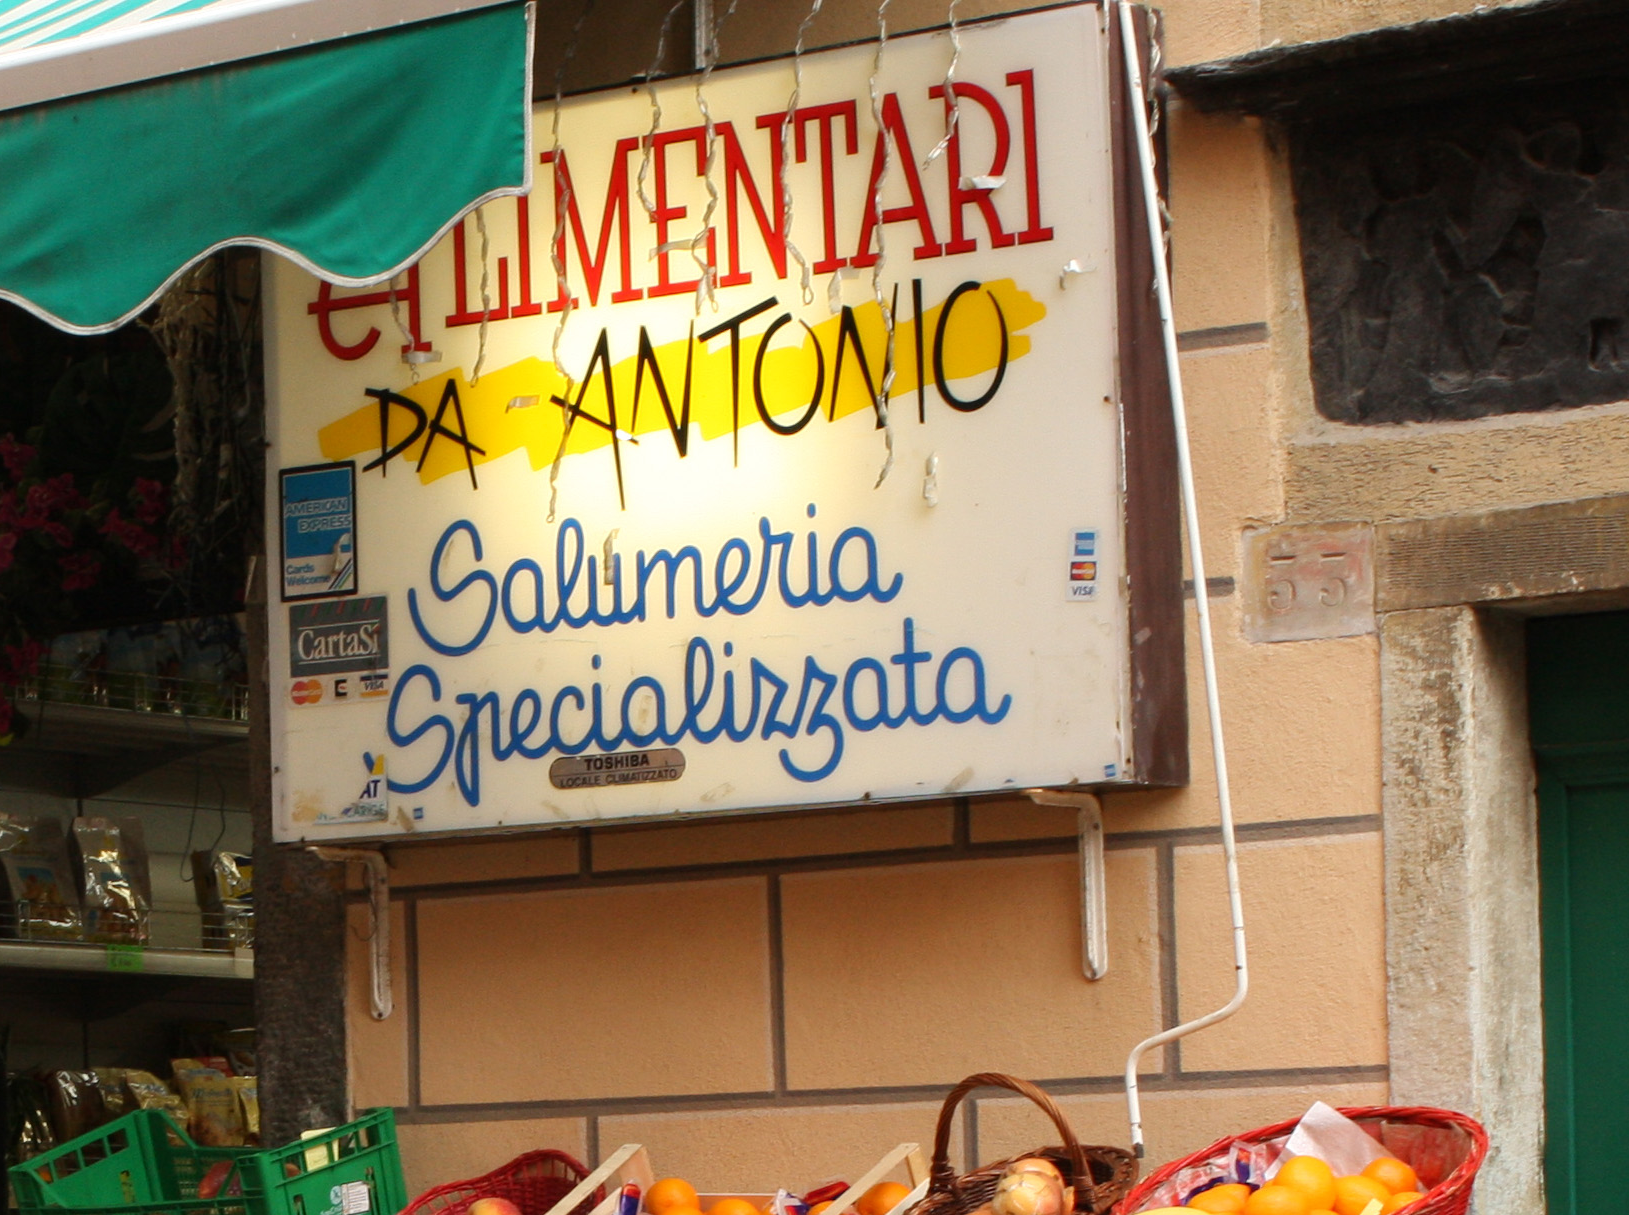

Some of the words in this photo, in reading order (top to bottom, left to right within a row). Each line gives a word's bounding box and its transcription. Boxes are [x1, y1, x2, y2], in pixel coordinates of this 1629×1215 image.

[362, 376, 487, 491] DA
[550, 279, 1009, 512] ANTONIO
[285, 499, 348, 517] AMERICAN
[298, 514, 352, 533] EXPRESS
[286, 563, 315, 575] Cards
[286, 574, 331, 587] Welcome
[408, 504, 903, 657] Salumeria
[1072, 586, 1096, 596] VISA
[364, 680, 384, 691] VISA
[363, 617, 1012, 807] Specializzata
[584, 753, 650, 771] TOSHIBA
[559, 776, 601, 788] LOCALE
[605, 769, 677, 784] CLIMATIZZATO
